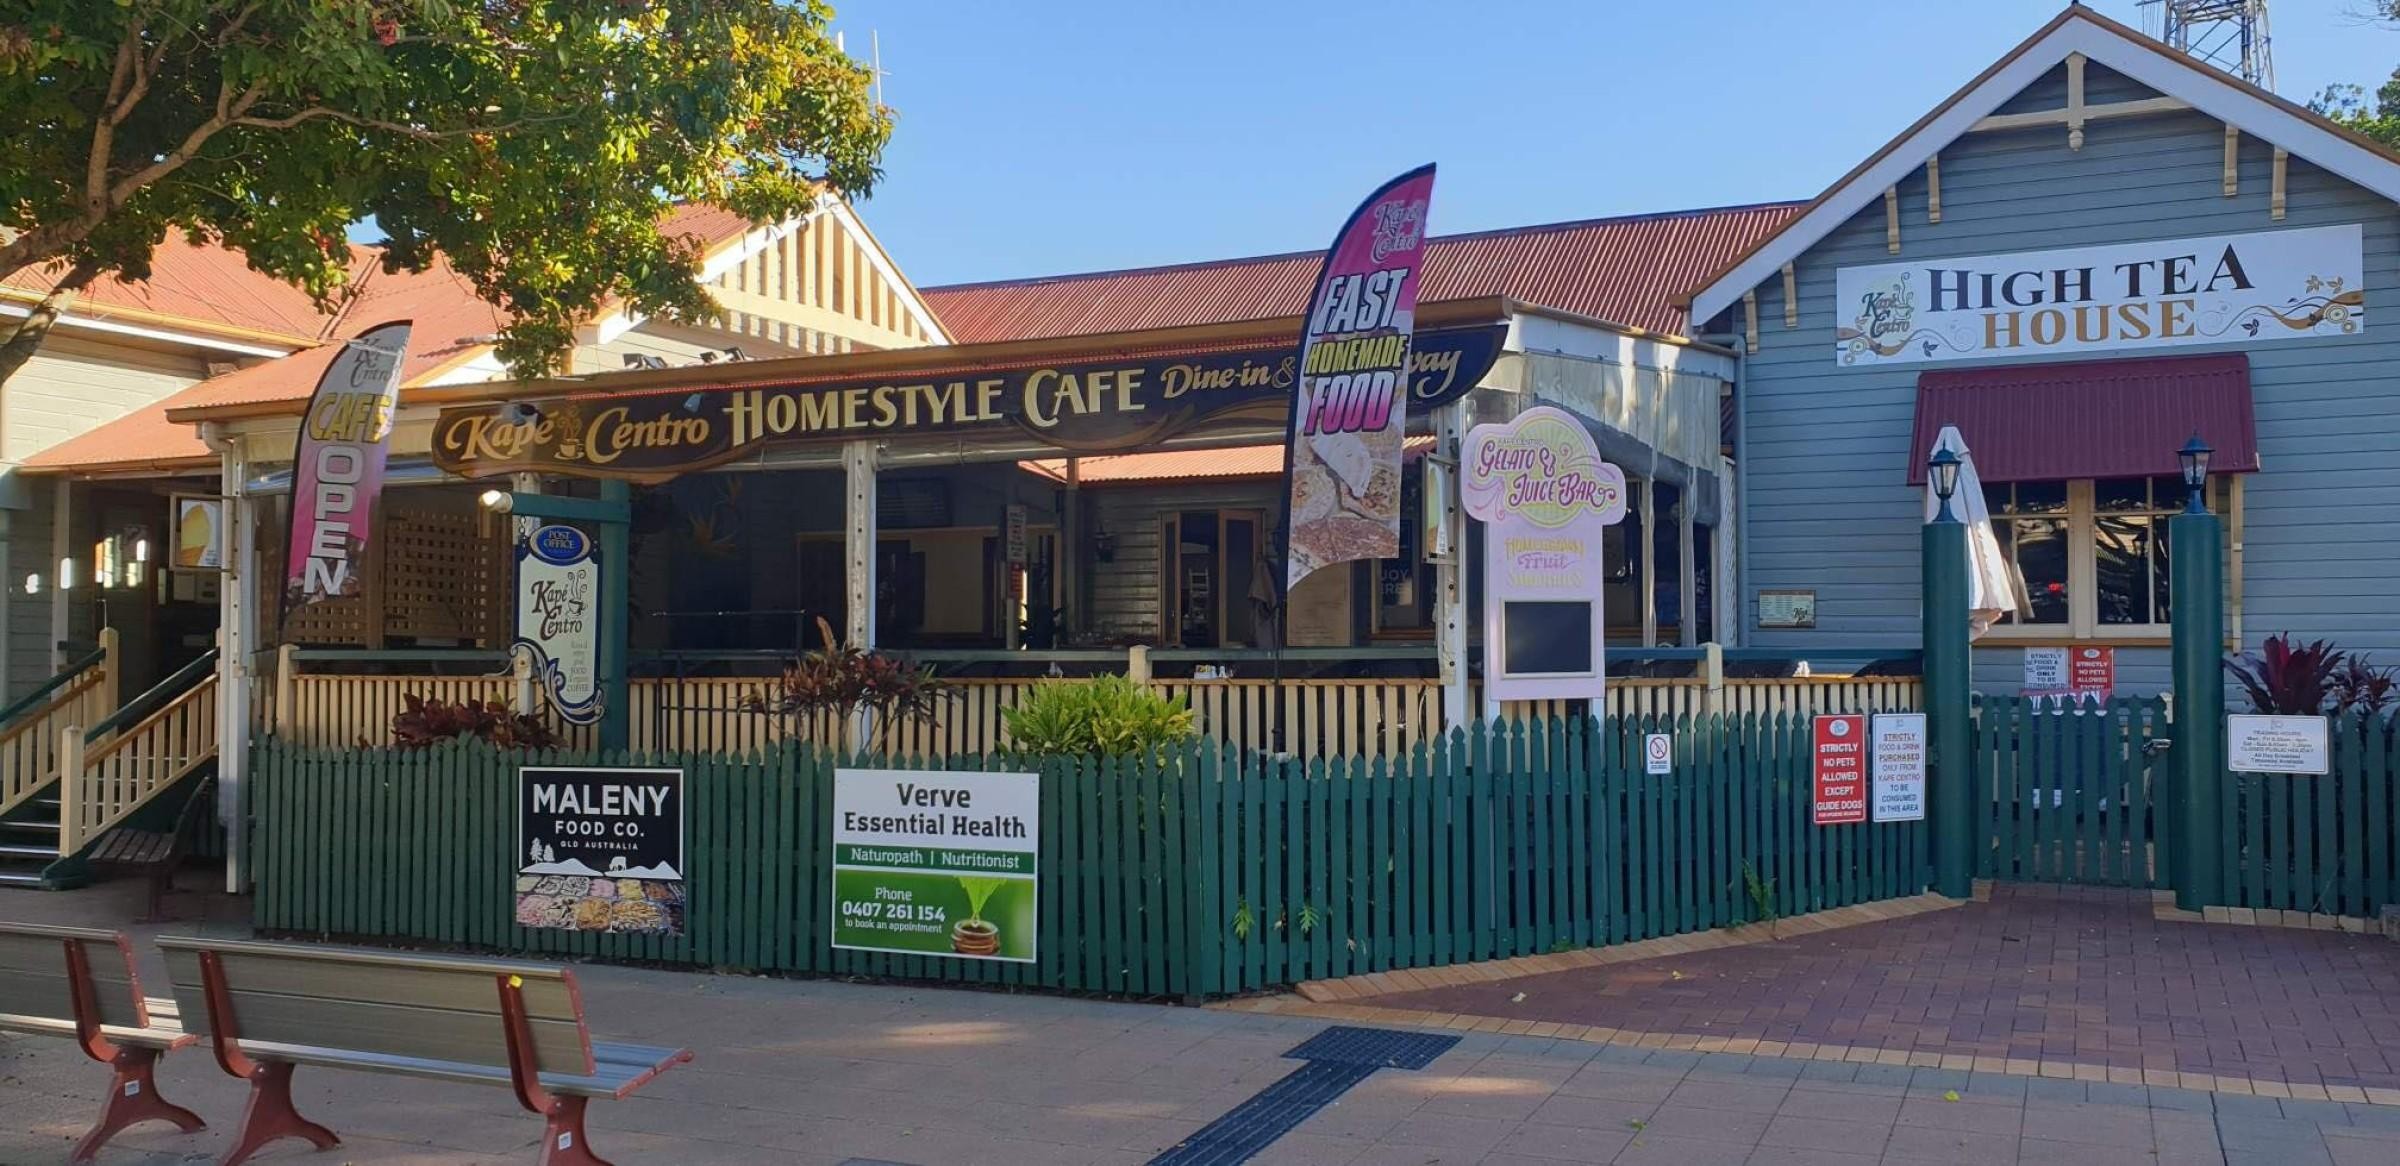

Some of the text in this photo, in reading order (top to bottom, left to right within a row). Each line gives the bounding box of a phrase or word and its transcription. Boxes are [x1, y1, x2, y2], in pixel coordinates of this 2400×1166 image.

[1924, 243, 2256, 312] HIGH TEA
[1311, 267, 1410, 336] FAST
[1981, 299, 2196, 350] HOUSE
[1304, 335, 1410, 377] HOMEMADE
[1303, 370, 1397, 437] FOOD
[585, 406, 710, 464] Centro
[723, 379, 1005, 447] HOMESTYLE
[1024, 367, 1146, 429] CAFE
[1161, 362, 1271, 400] Dine-in
[303, 445, 363, 595] OPEN
[548, 530, 571, 539] POST
[543, 539, 576, 549] OFFICE
[540, 602, 583, 640] Centro
[1883, 733, 1917, 741] STRICTLY
[1820, 743, 1858, 753] STRICTLY
[1879, 743, 1896, 751] FOOD
[1823, 758, 1856, 767] NO PETS
[1879, 754, 1920, 762] PURCHASED
[1882, 763, 1917, 771] ONLY FROM
[1822, 772, 1858, 782] ALLOWED
[1896, 773, 1921, 781] CENTRO
[897, 783, 971, 808] Verve
[1824, 786, 1854, 796] EXCEPT
[1881, 794, 1917, 803] CONSUMED
[533, 783, 670, 817] MALENY
[1816, 800, 1863, 811] GUIDE DOGS
[1901, 804, 1919, 812] AREA
[555, 820, 645, 837] FOOD CO.
[844, 812, 1027, 838] Essential Health
[585, 841, 639, 850] AUSTRALIA
[851, 847, 1020, 869] Naturopath Nutritionist
[875, 886, 913, 901] Phone
[842, 901, 946, 923] 0407 261 154
[845, 919, 943, 934] to book an appointment
